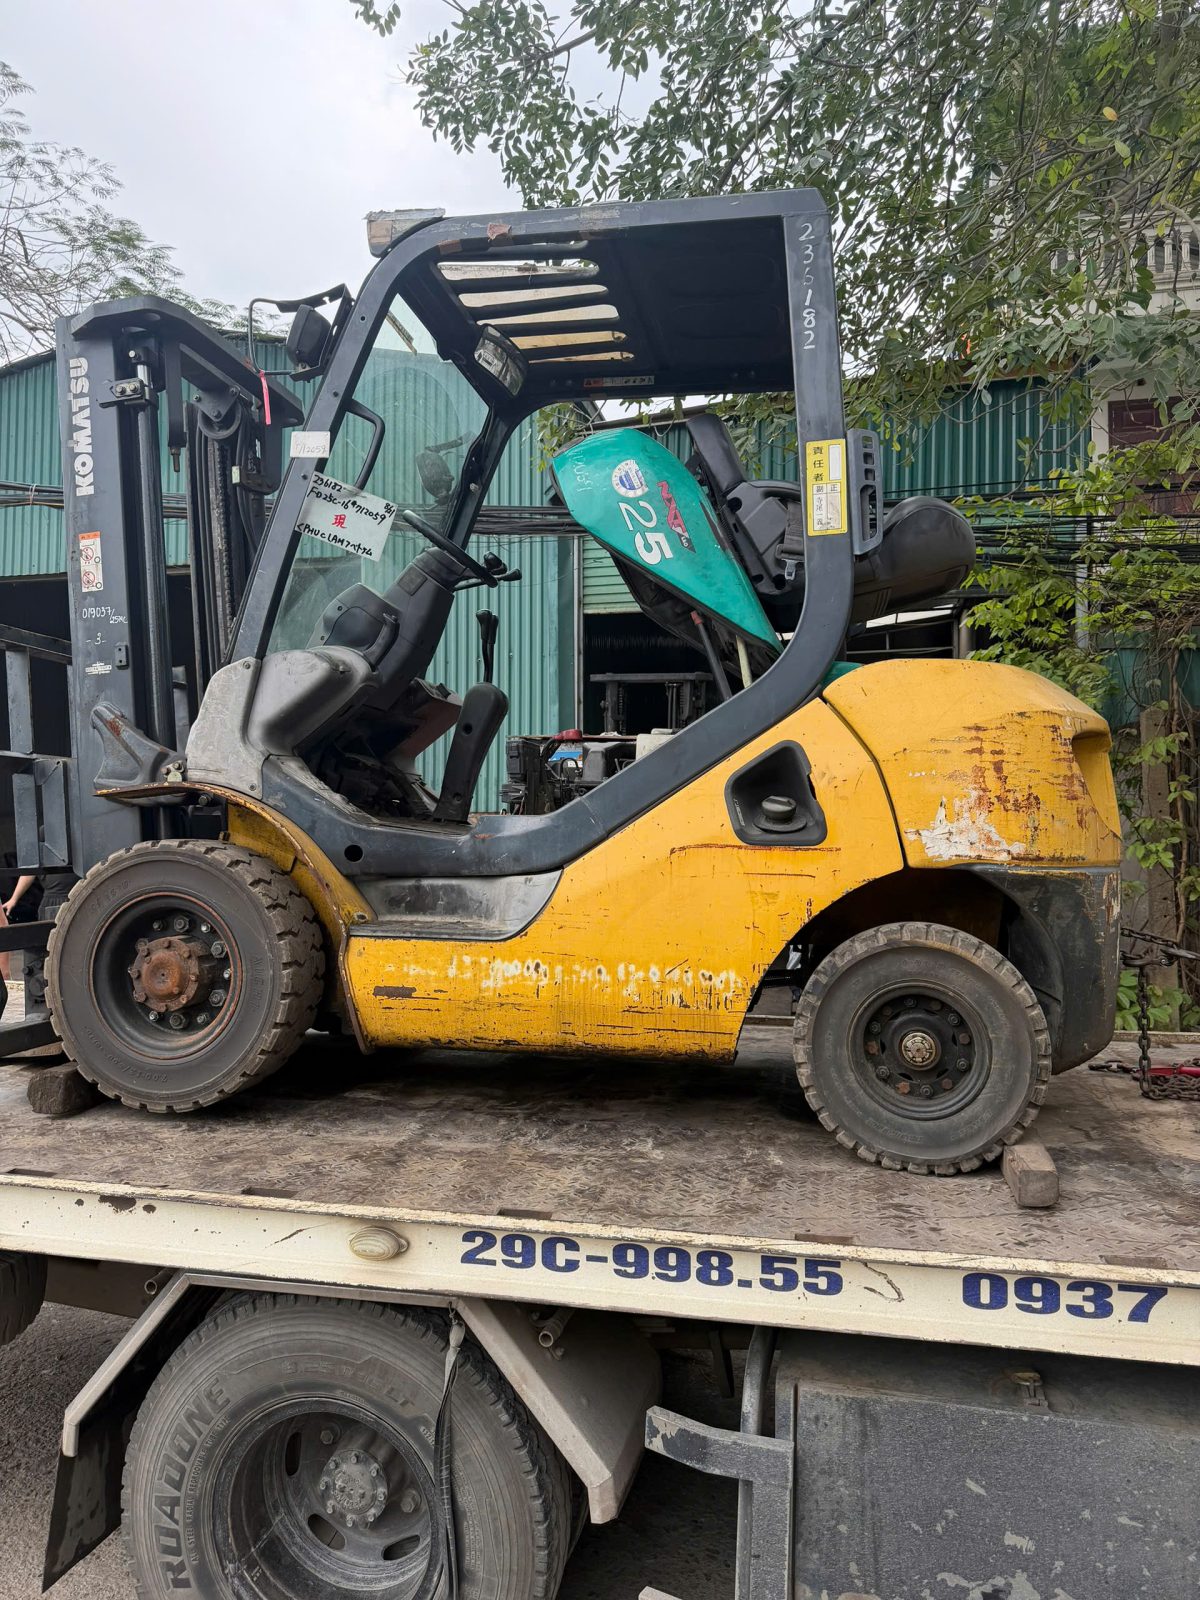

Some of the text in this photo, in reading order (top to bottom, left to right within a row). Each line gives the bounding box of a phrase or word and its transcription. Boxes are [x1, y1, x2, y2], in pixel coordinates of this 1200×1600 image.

[798, 222, 816, 350] 236182
[69, 357, 95, 497] KOMATSU
[617, 500, 674, 566] 25
[461, 1229, 843, 1296] 29C-998.55
[961, 1271, 1169, 1323] 0937
[153, 1377, 232, 1590] ROADONE
